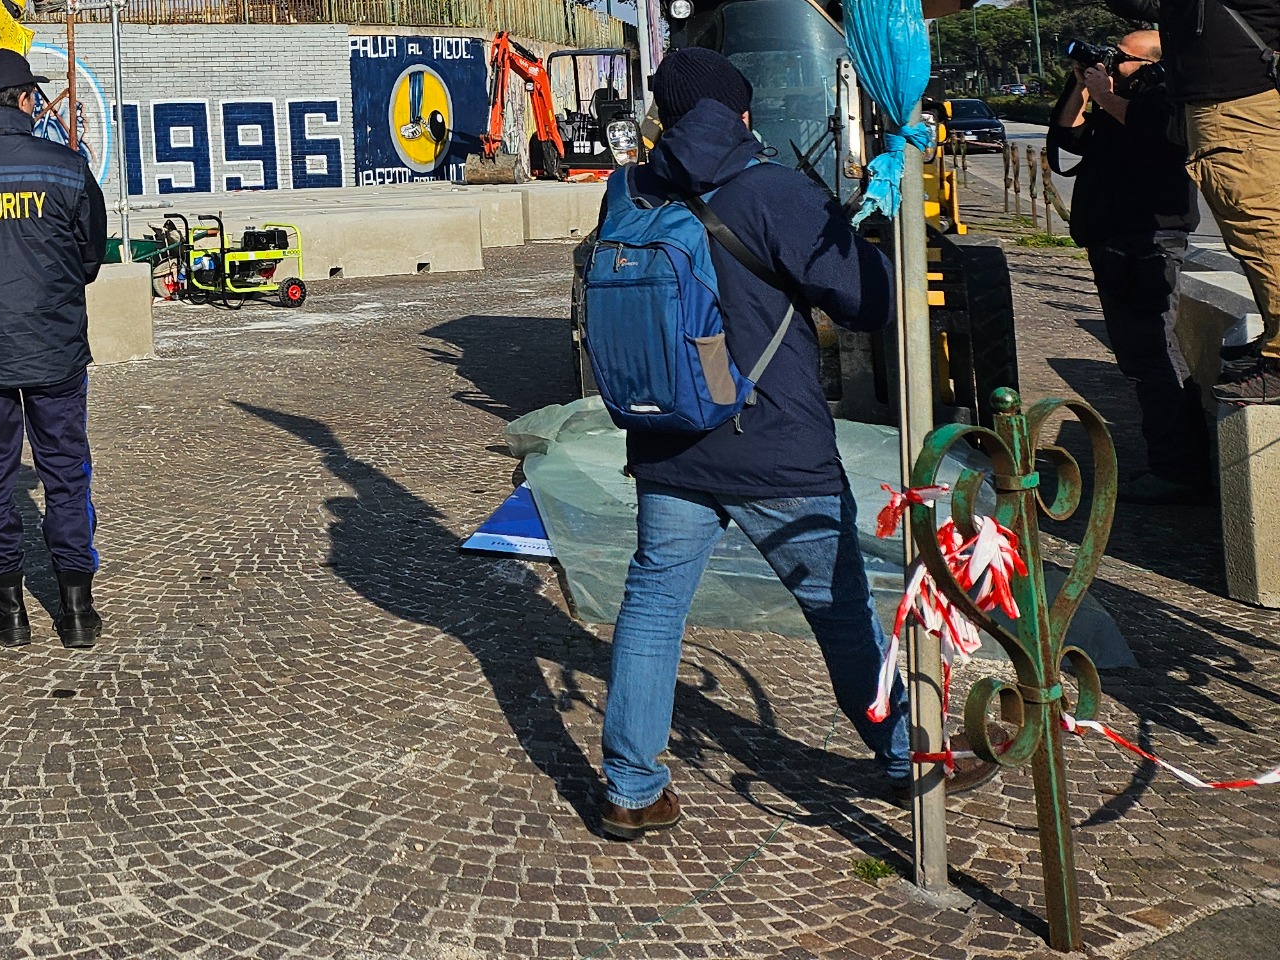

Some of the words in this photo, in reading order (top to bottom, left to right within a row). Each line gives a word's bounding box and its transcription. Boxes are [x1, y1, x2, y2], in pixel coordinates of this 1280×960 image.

[348, 36, 396, 57] PALLA
[408, 43, 422, 54] AL
[110, 97, 346, 195] 1996
